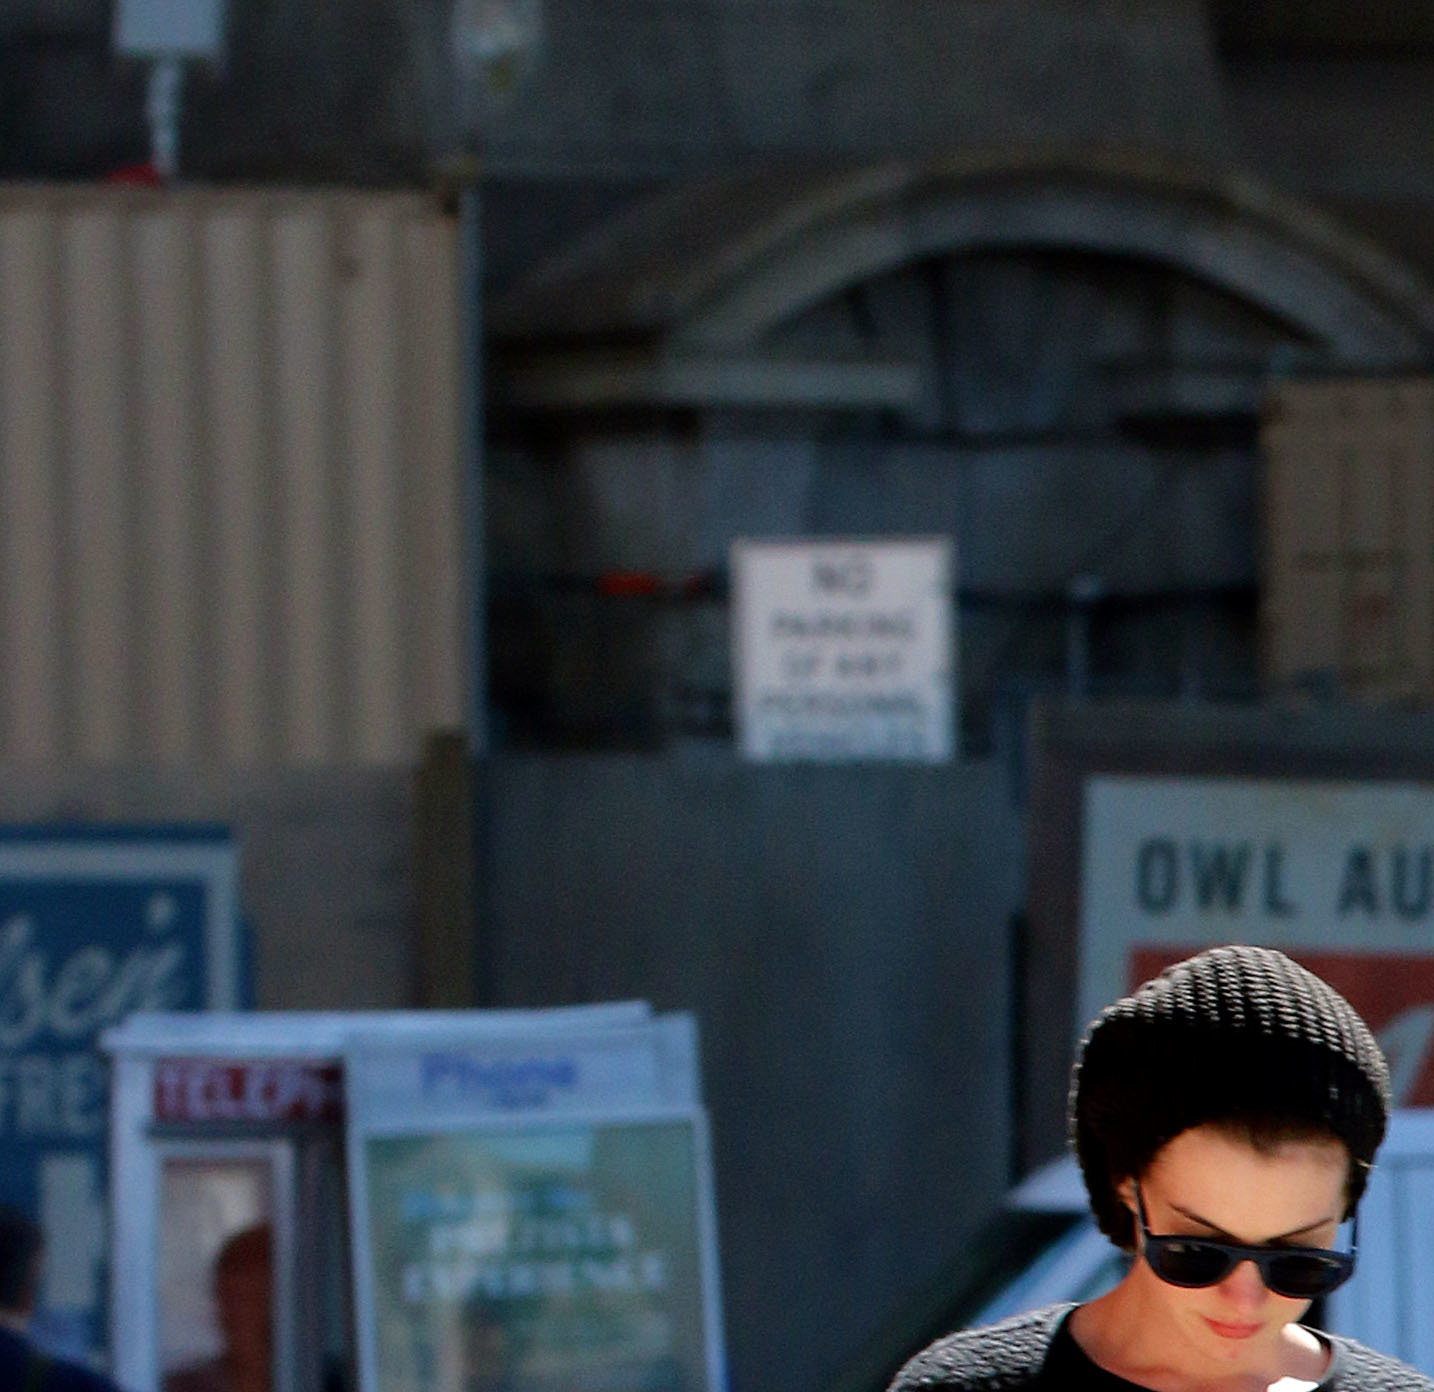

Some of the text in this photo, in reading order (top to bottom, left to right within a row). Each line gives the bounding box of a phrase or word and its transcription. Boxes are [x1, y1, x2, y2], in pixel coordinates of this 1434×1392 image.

[811, 558, 873, 598] NO
[770, 611, 915, 639] PARKING
[1137, 838, 1299, 919] OWL
